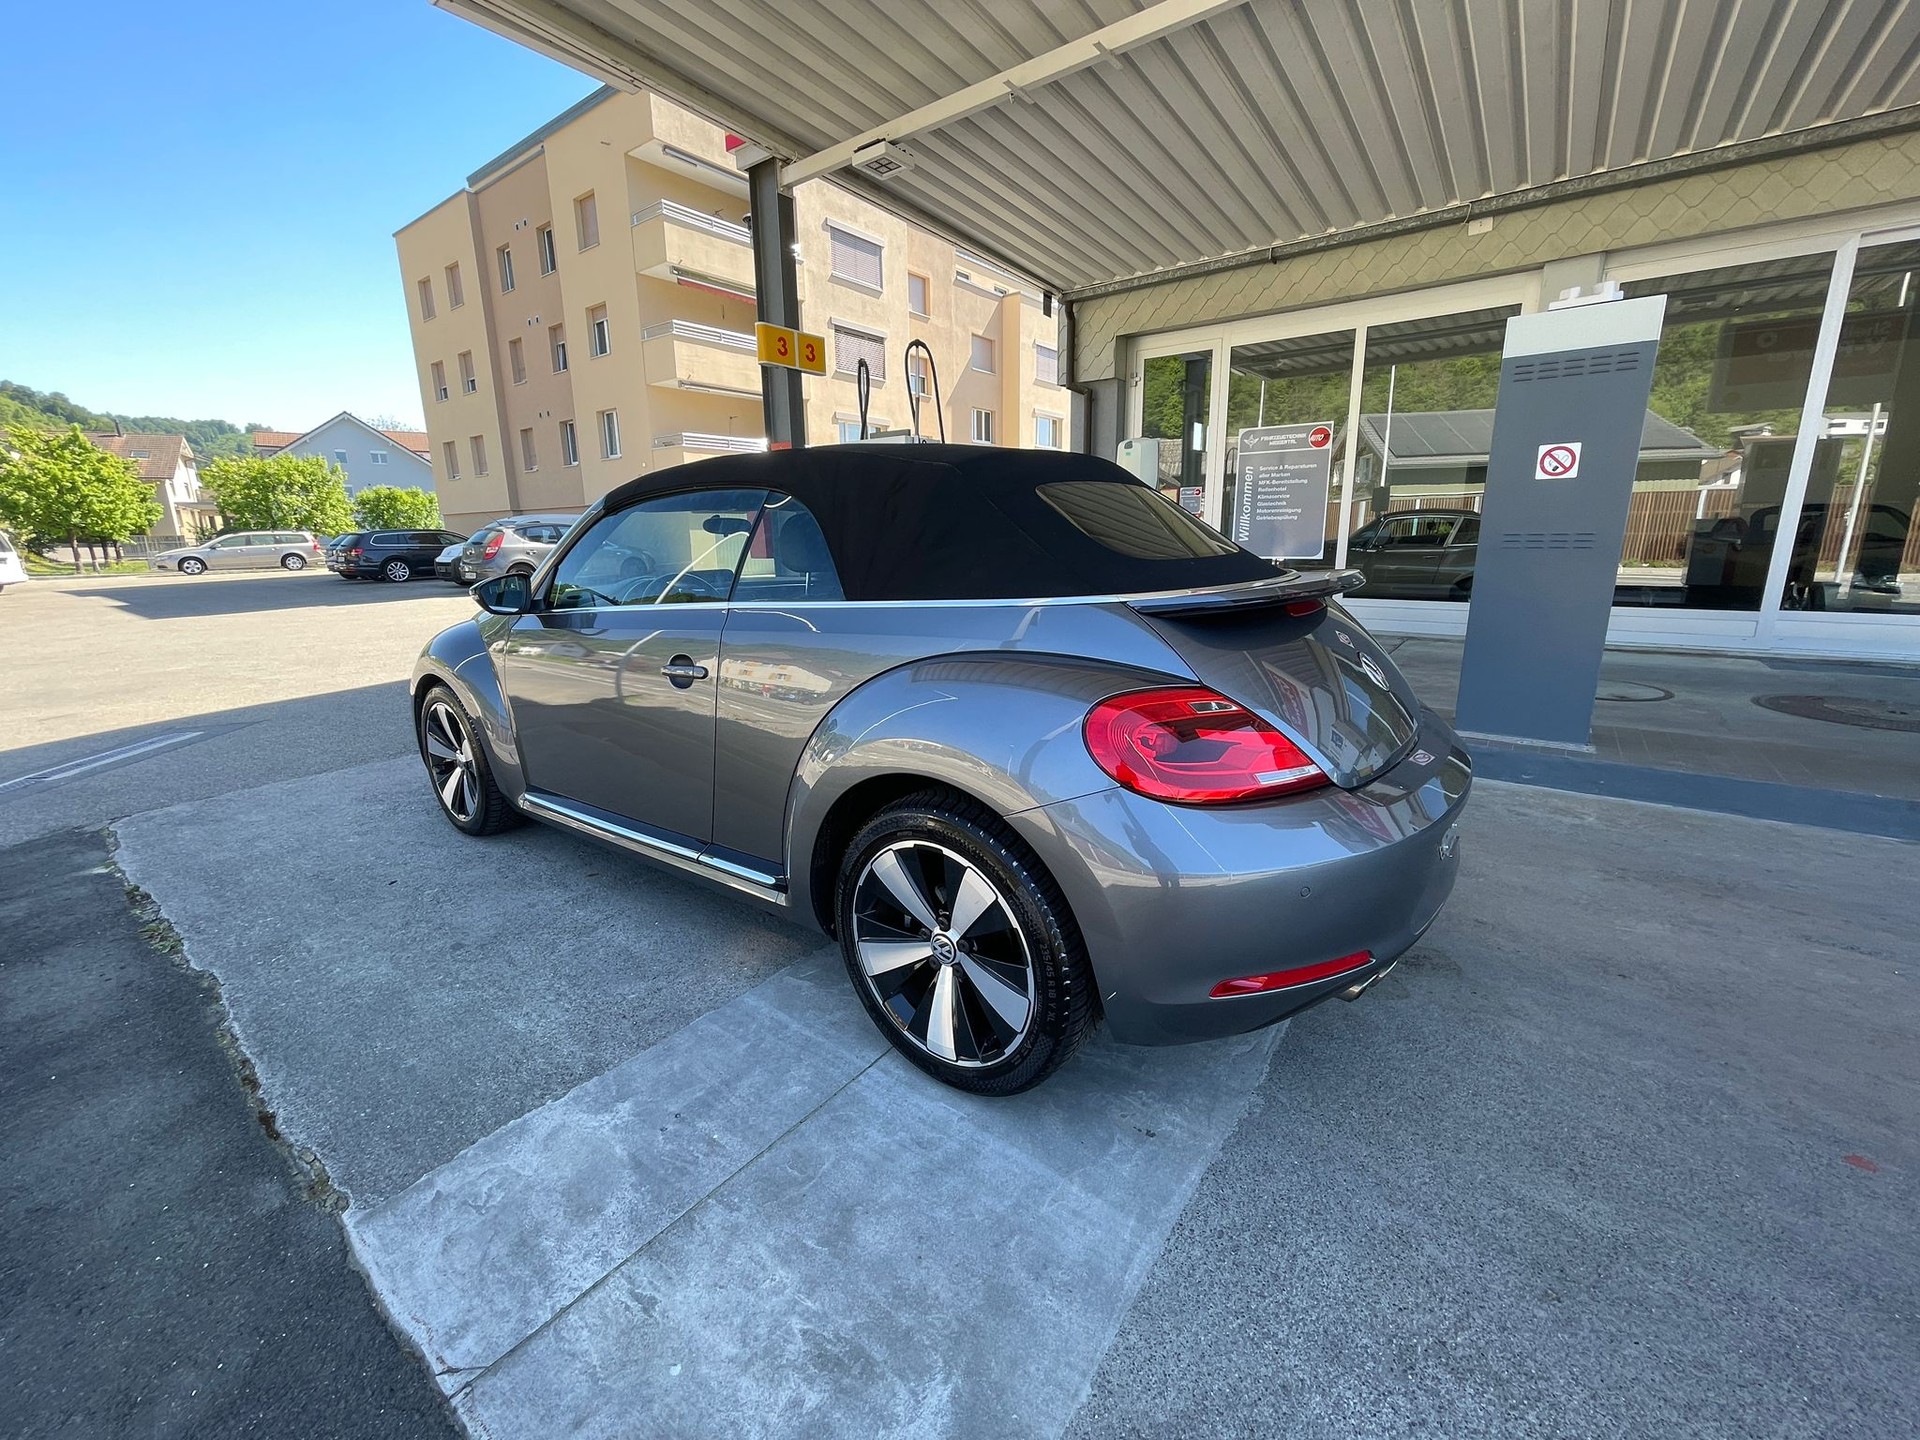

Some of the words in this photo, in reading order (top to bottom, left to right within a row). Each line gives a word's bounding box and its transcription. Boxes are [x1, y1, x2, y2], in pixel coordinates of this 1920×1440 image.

[777, 336, 788, 356] 3
[805, 343, 816, 362] 3
[1238, 465, 1254, 542] Willkommen
